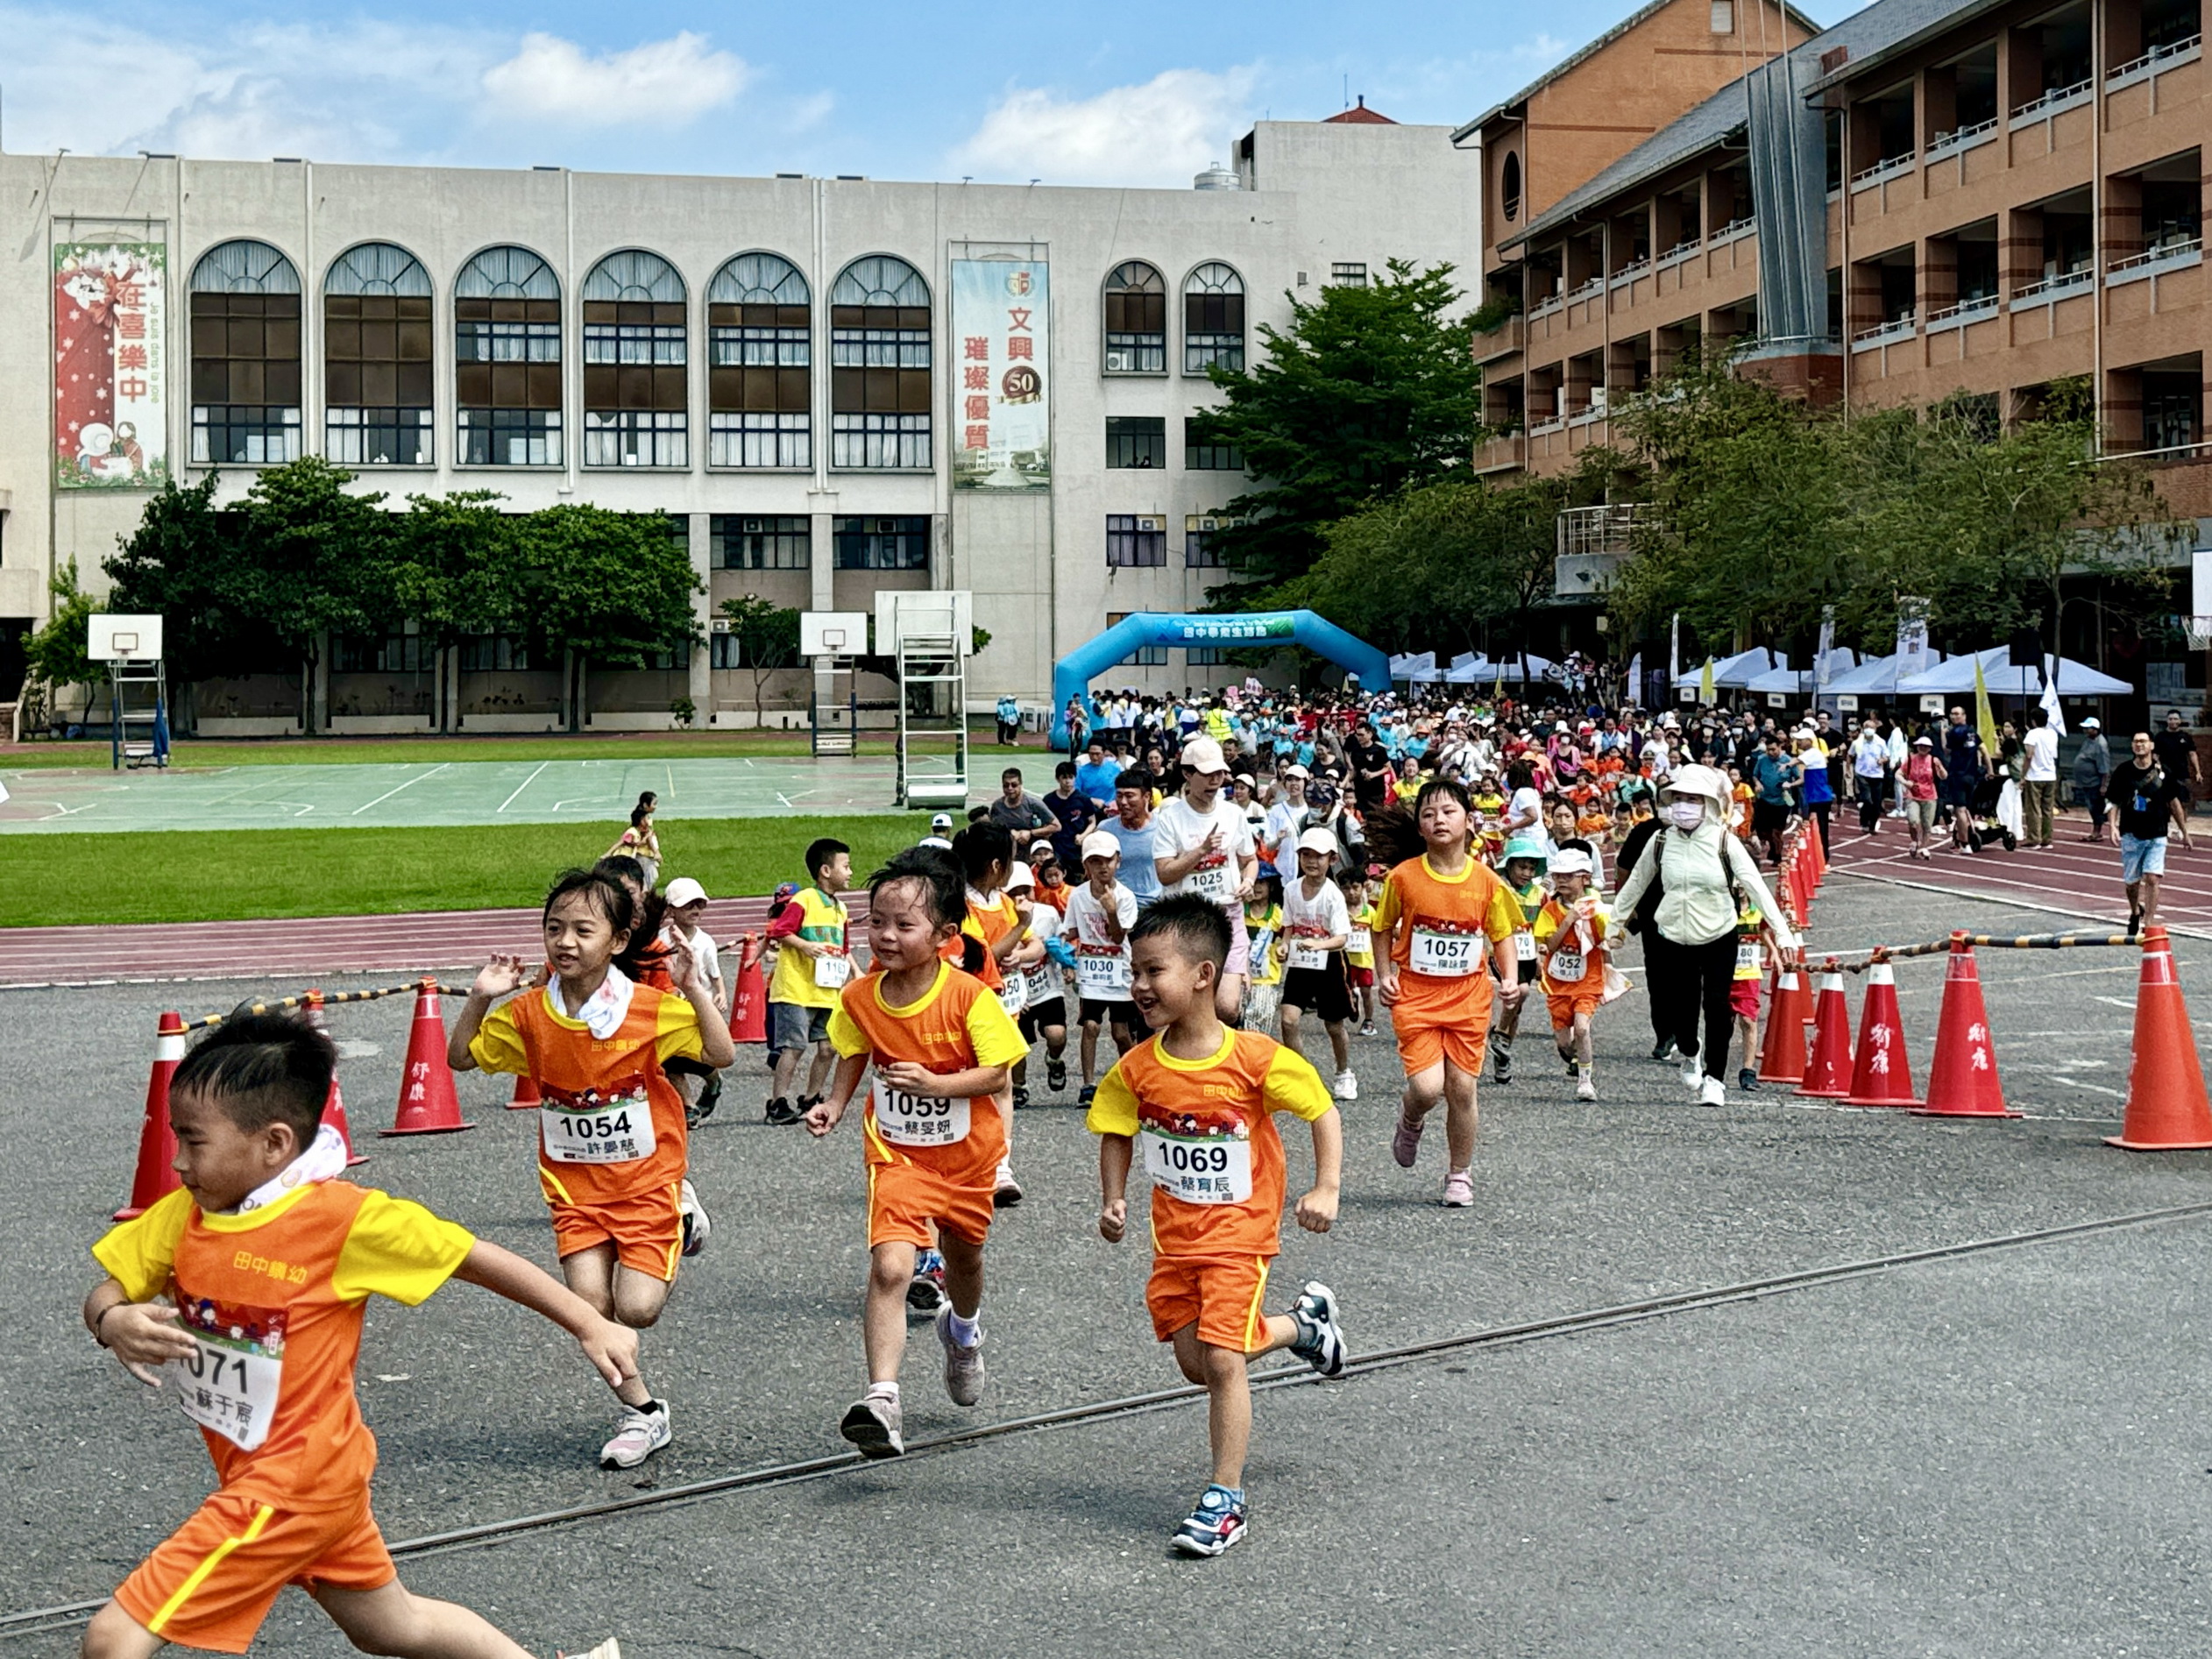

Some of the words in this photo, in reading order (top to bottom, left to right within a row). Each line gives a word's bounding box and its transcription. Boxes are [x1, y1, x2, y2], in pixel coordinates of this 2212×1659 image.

[150, 318, 160, 339] suis
[1008, 307, 1033, 361] 文興
[117, 280, 147, 403] 在喜樂中
[150, 343, 160, 368] dans
[151, 372, 160, 381] la
[1006, 372, 1034, 392] 50
[149, 385, 160, 403] joie
[964, 336, 990, 450] 璀璨優質
[1191, 871, 1223, 886] 1025
[1424, 939, 1471, 957] 1057
[1084, 959, 1114, 973] 1030
[884, 1089, 951, 1117] 1059
[560, 1110, 632, 1138] 1054
[1159, 1142, 1228, 1173] 1069
[180, 1343, 248, 1394] 071
